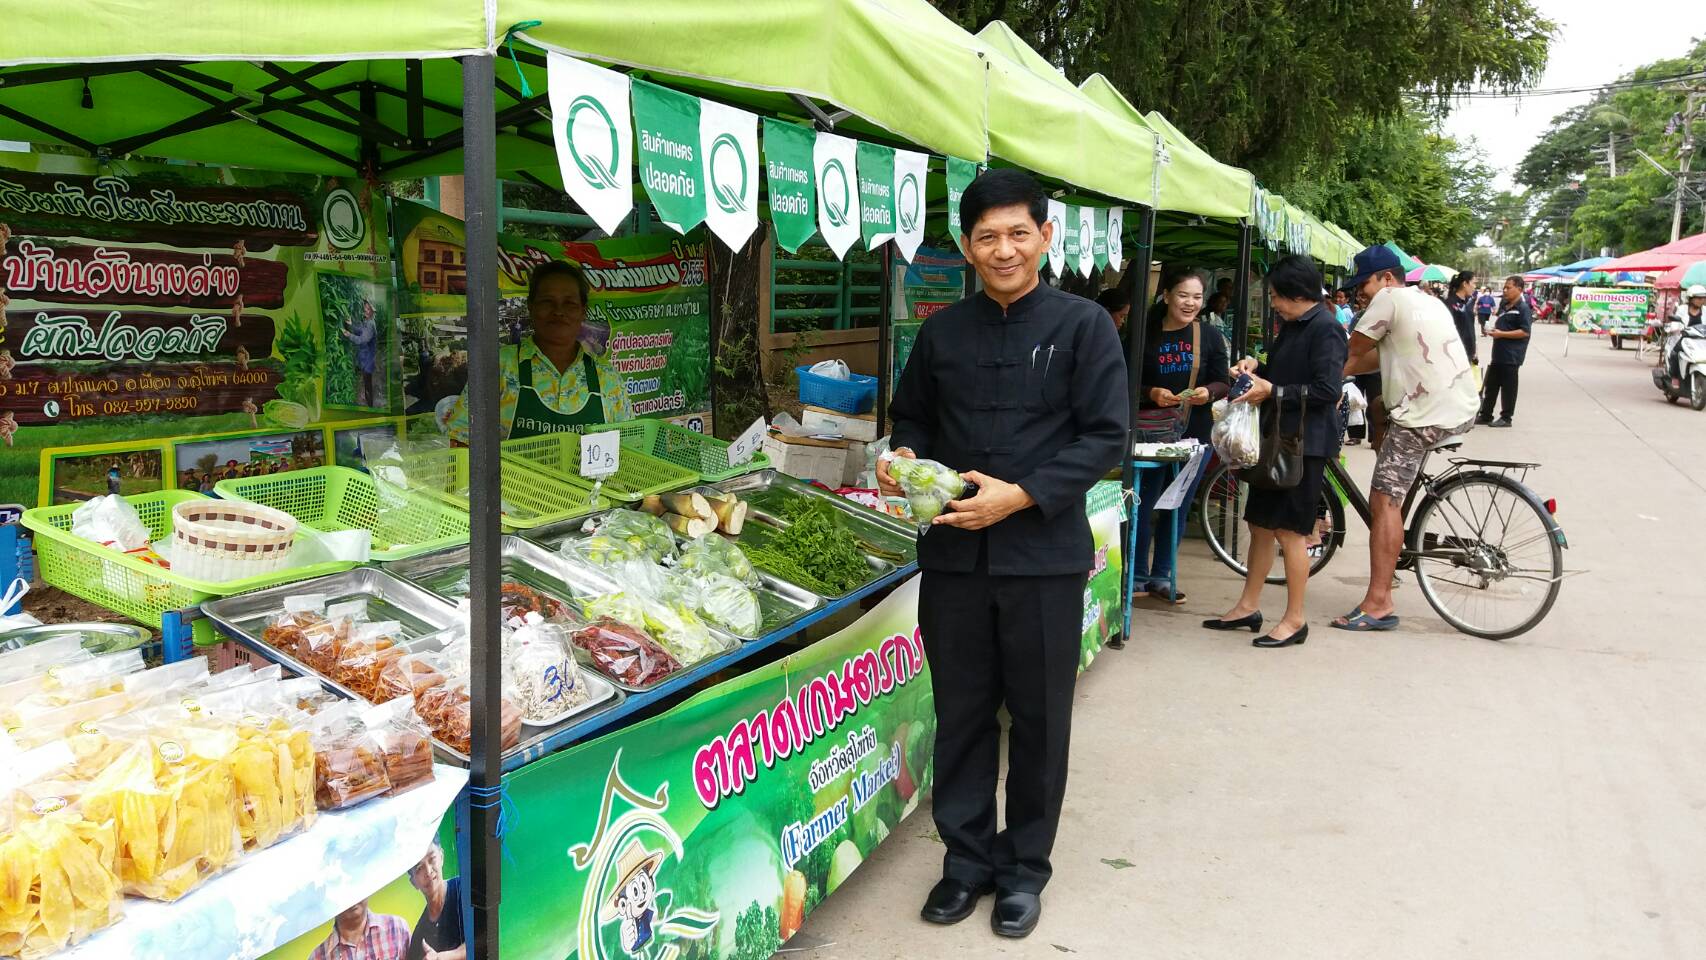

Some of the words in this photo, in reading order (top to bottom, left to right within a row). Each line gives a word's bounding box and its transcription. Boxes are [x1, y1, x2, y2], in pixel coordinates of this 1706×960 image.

[641, 129, 694, 162] สินค้าเกษตร
[645, 163, 696, 199] ปลอดภัย
[768, 161, 809, 185] สินค้าเกษตร
[860, 178, 890, 198] สินค้าเกษตร
[771, 188, 809, 216] ปลอดภัย
[861, 201, 891, 226] ปลอดภัย
[21, 311, 228, 360] ผักปลอดภัย
[612, 329, 673, 351] ผักปลอดสารพิษ
[15, 381, 40, 396] ม.7
[47, 376, 119, 395] ต.ปากแคว
[125, 371, 171, 392] อ.เมือง
[232, 371, 268, 385] 64000
[63, 394, 97, 417] โทร.
[103, 396, 197, 415] 082-557-5850
[516, 416, 597, 433] ตลาดเกษต
[587, 444, 601, 465] 10
[736, 443, 746, 456] 5
[691, 624, 926, 808] ตลาดเกษตรกร
[809, 725, 876, 791] จังหวัดสุโขทัย
[780, 794, 850, 872] (Farmer
[851, 741, 901, 814] Market)
